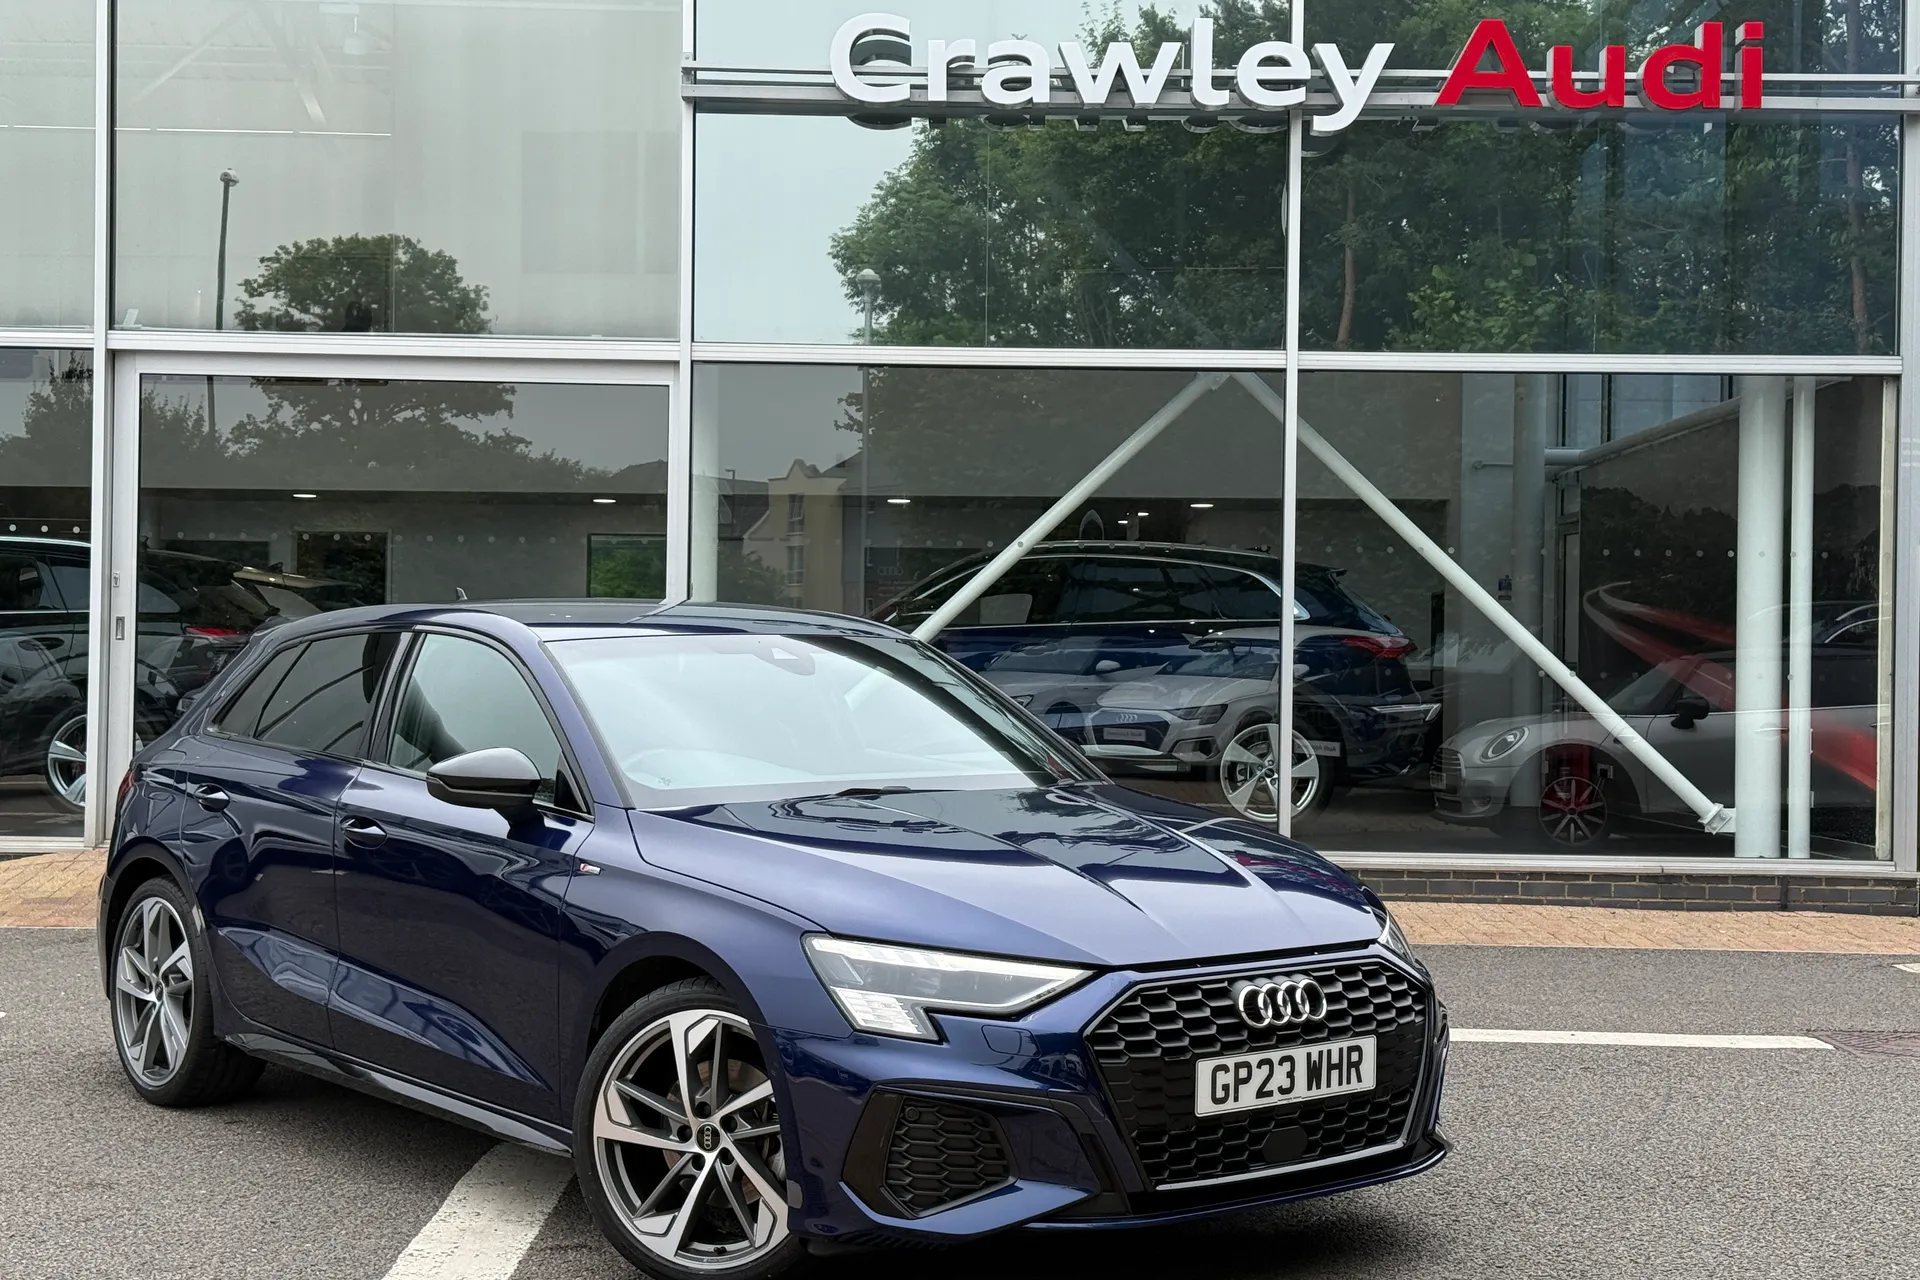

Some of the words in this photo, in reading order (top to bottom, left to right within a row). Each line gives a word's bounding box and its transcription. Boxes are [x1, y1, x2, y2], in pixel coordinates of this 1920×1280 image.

[829, 12, 1395, 134] Crawley
[1434, 18, 1764, 110] Audi
[1210, 1054, 1296, 1106] GP23
[1306, 1044, 1364, 1092] WHR
